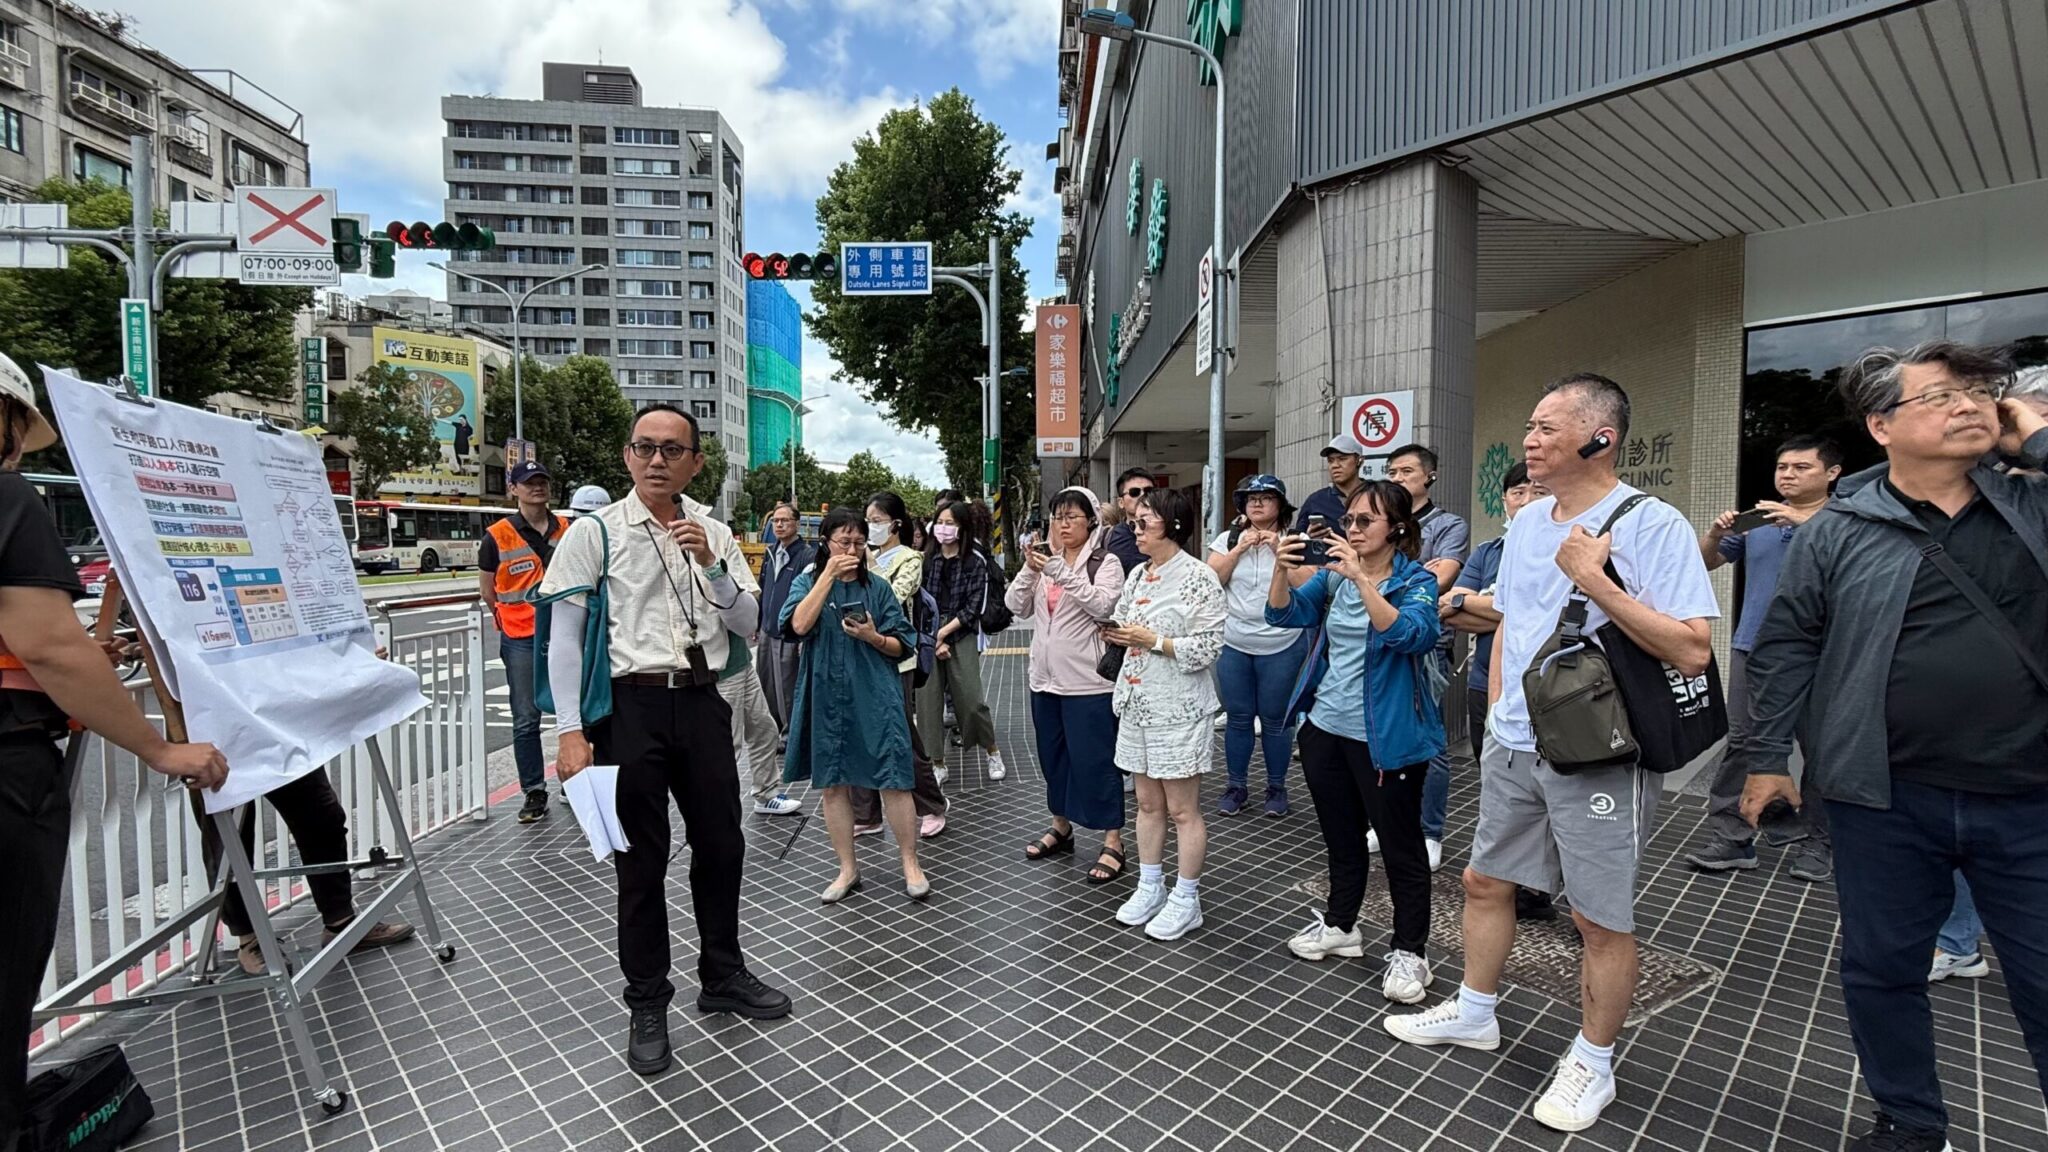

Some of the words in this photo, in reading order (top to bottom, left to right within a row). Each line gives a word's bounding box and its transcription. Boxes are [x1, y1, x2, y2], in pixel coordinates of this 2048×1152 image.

[847, 247, 926, 262] 外側車道
[244, 258, 333, 271] 07:00-09:00
[847, 264, 926, 278] 專用號誌
[848, 280, 871, 288] Outside
[872, 280, 891, 288] Lanes
[891, 280, 911, 289] Signal
[912, 280, 926, 289] Only
[409, 346, 469, 366] 互動美語
[1049, 334, 1067, 423] 家樂福超市
[1362, 410, 1387, 437] 停
[1618, 467, 1673, 487] CLINIC
[182, 583, 201, 598] 116
